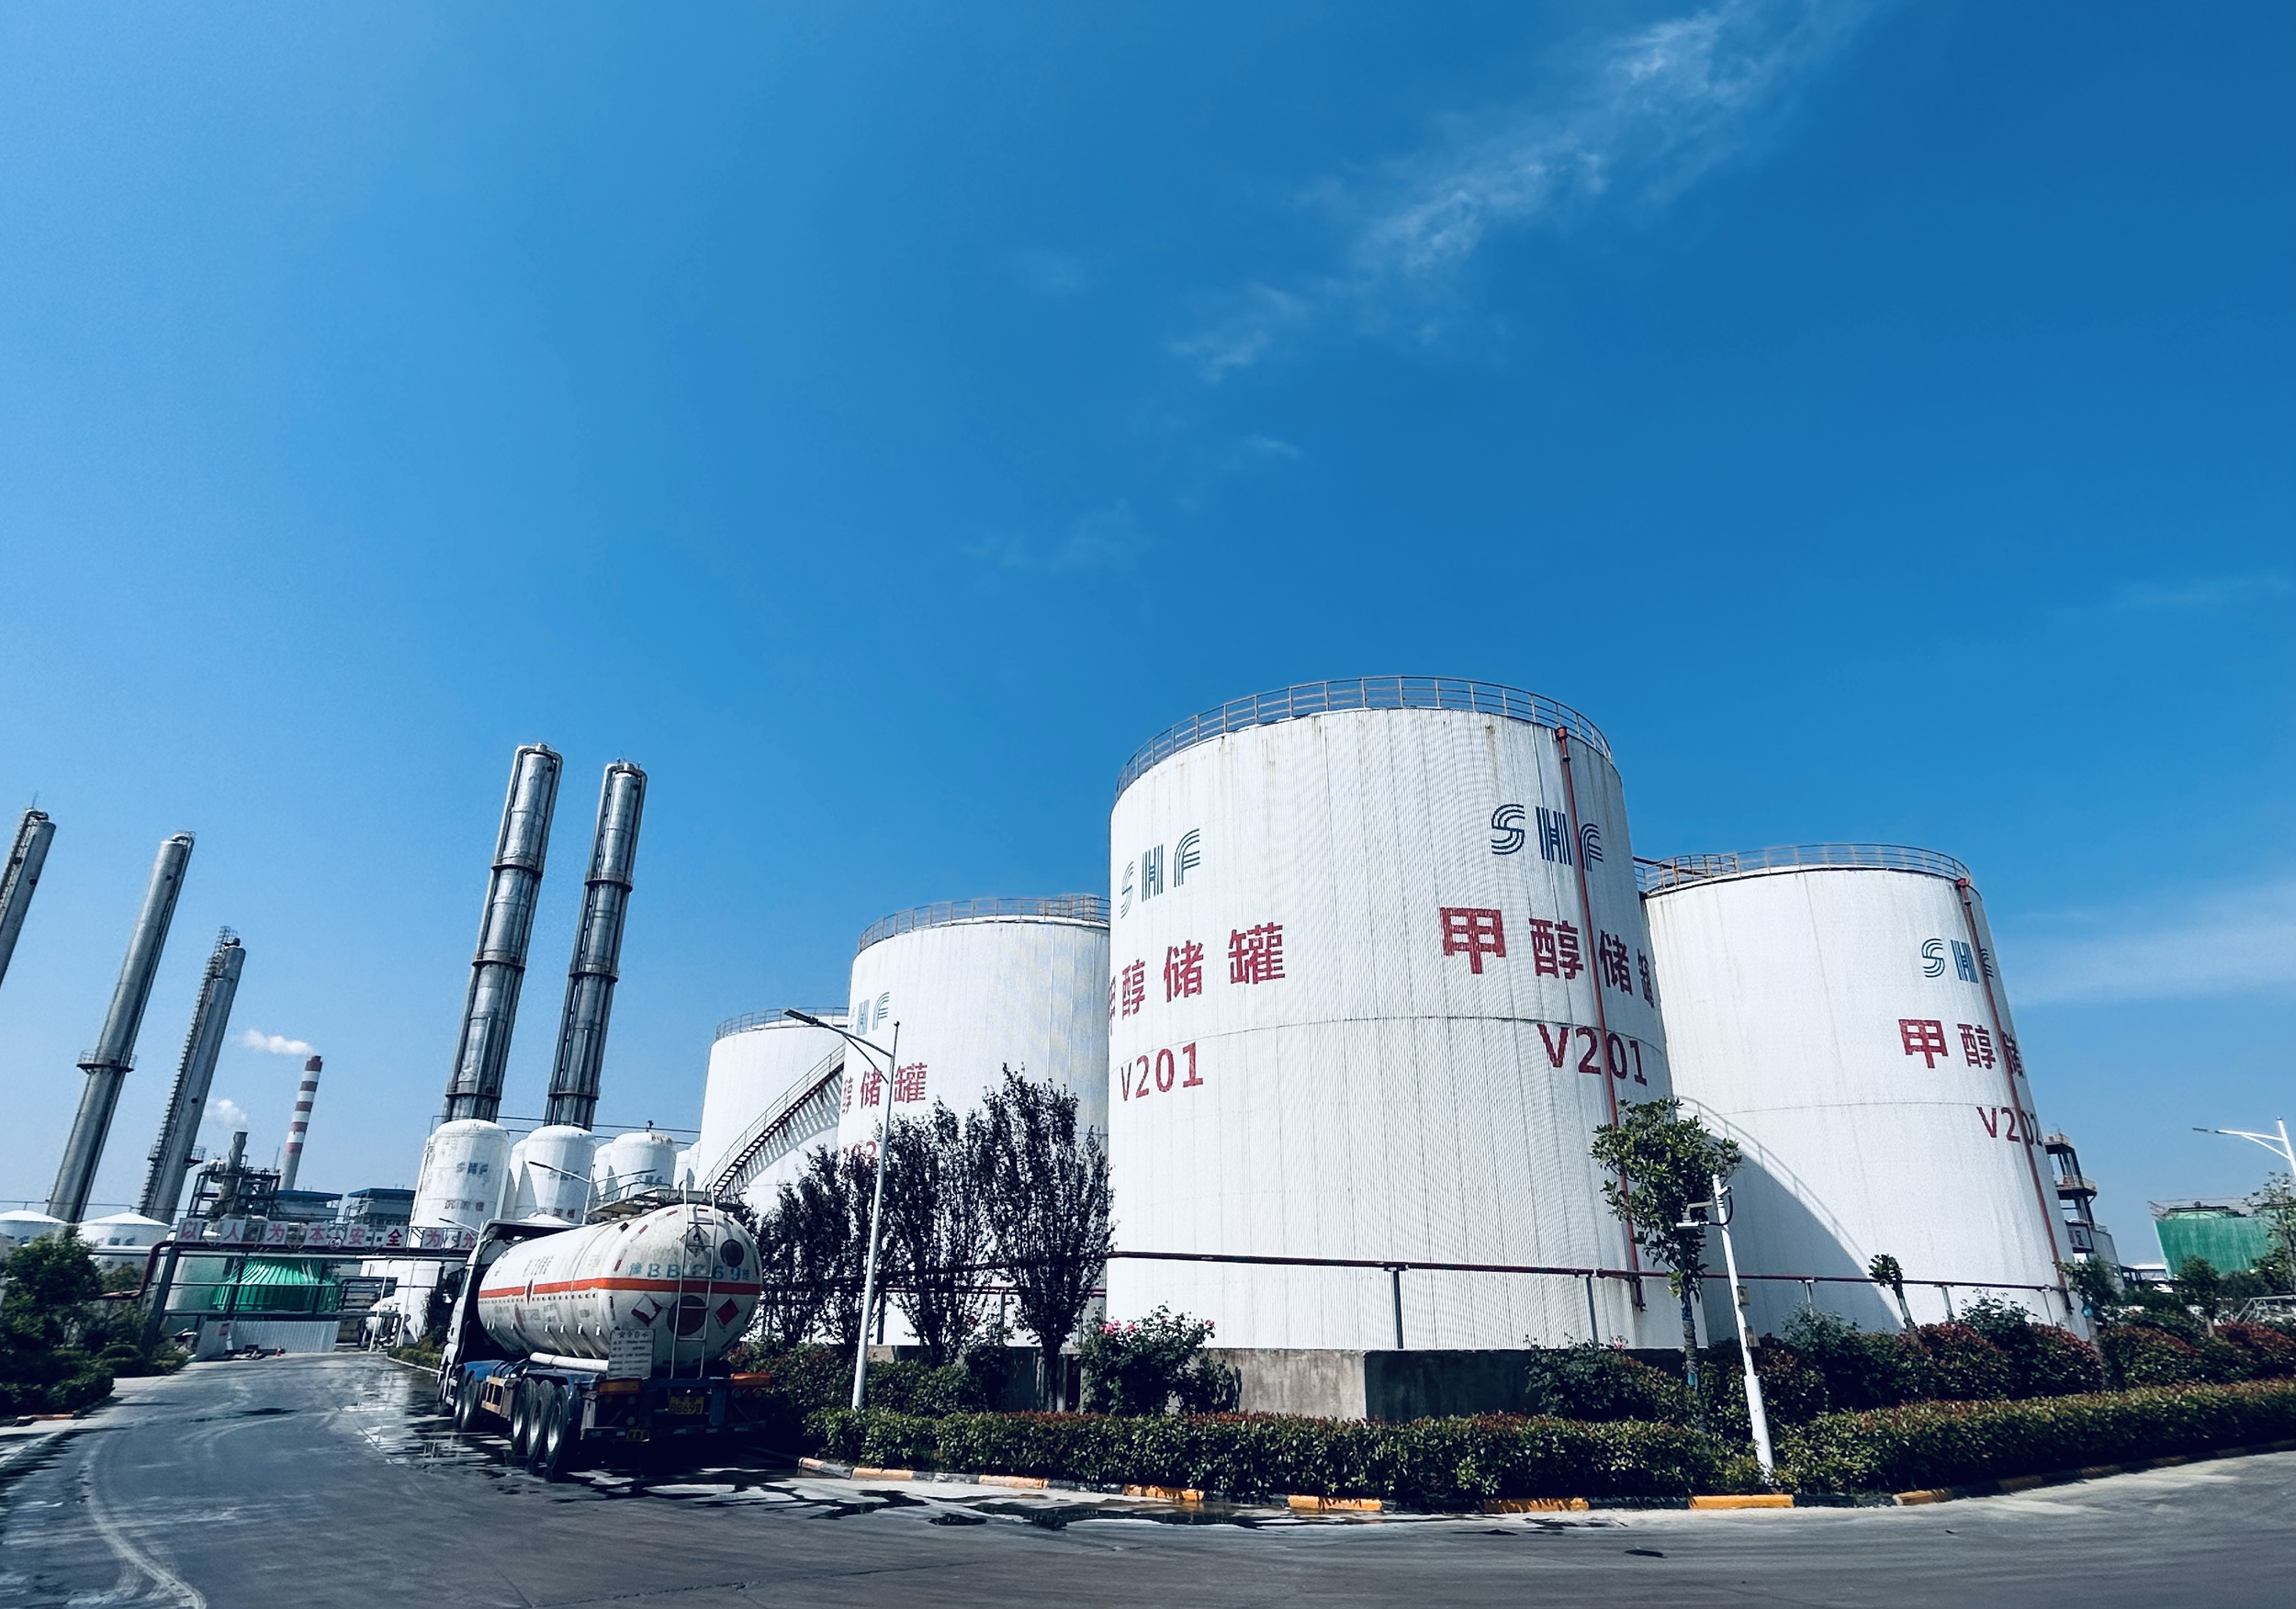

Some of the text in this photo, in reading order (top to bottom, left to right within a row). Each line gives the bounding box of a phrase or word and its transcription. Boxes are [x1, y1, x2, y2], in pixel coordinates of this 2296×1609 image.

[1491, 804, 1604, 872] SHF
[1121, 828, 1200, 918] SHF
[1440, 907, 1655, 1008] 甲醇储罐
[1120, 1041, 1204, 1102] V201
[1537, 1024, 1648, 1086] V201
[456, 1162, 489, 1176] SHF
